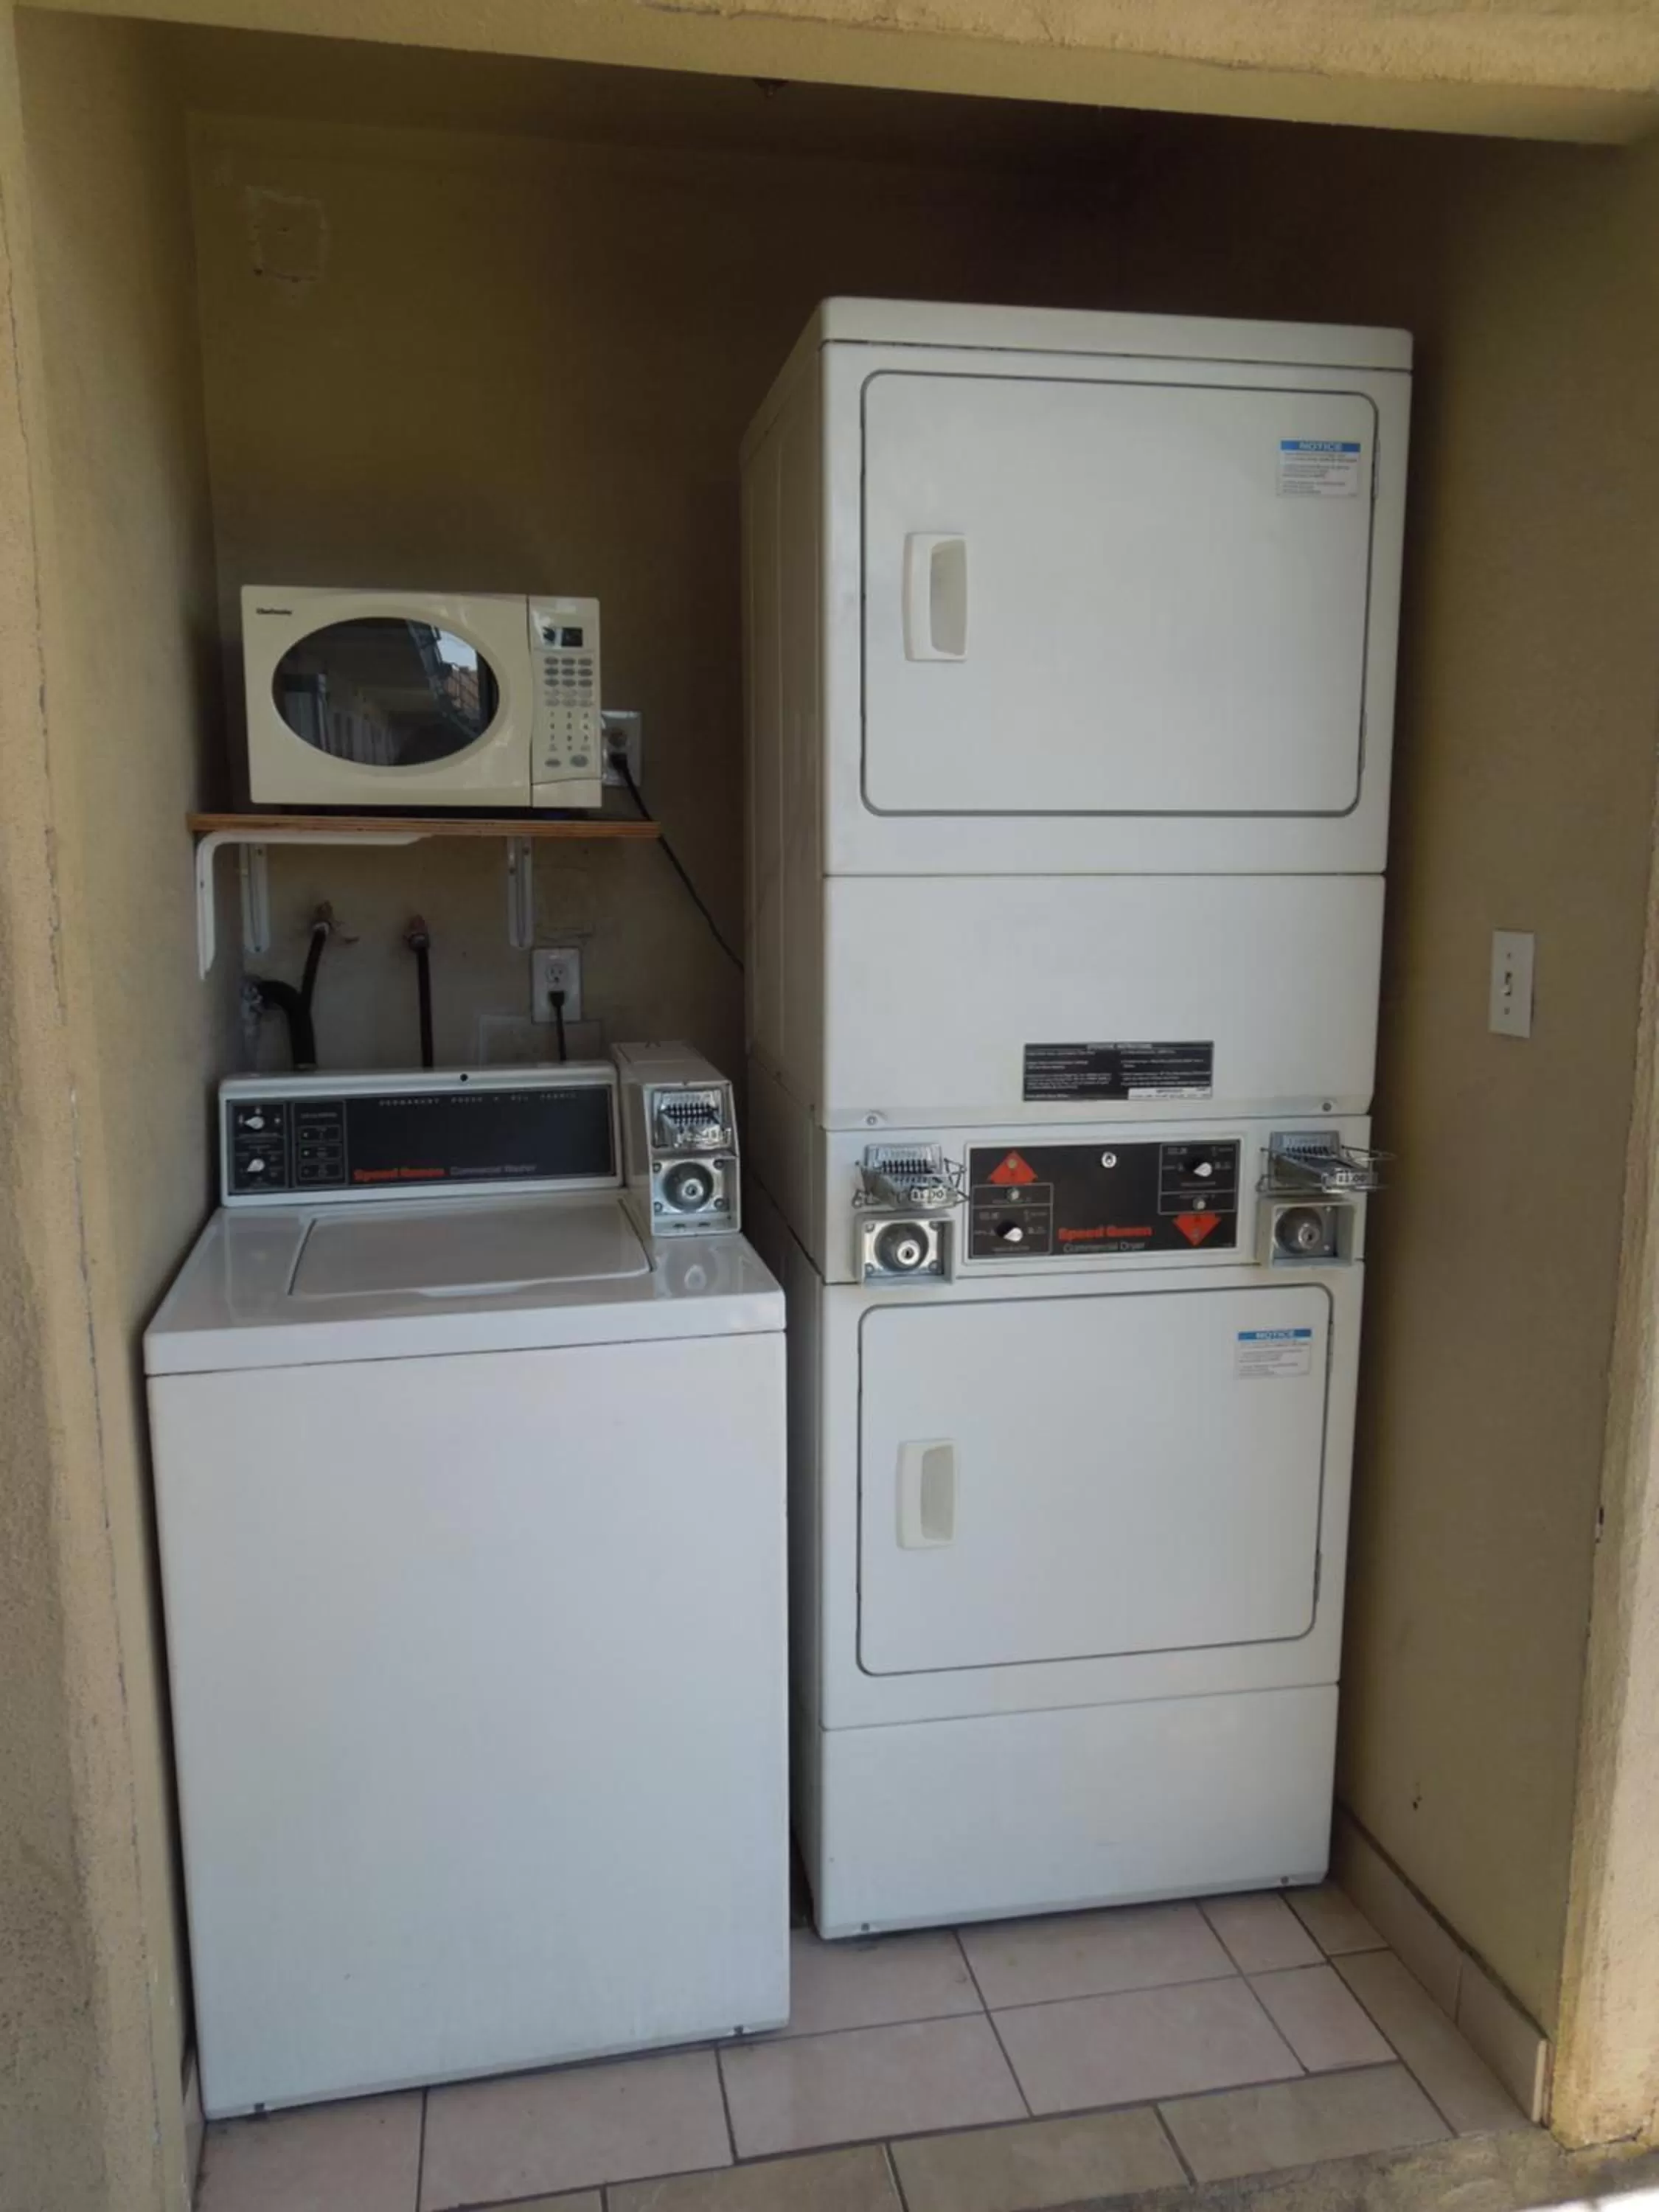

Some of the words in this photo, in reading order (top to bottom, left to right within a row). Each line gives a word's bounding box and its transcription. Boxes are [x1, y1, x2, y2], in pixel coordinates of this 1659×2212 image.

[1299, 442, 1343, 452] NOTICE
[1058, 1225, 1104, 1241] Speed
[1106, 1225, 1152, 1237] Queen
[1063, 1242, 1119, 1253] Commercial
[1120, 1240, 1146, 1251] Dryer
